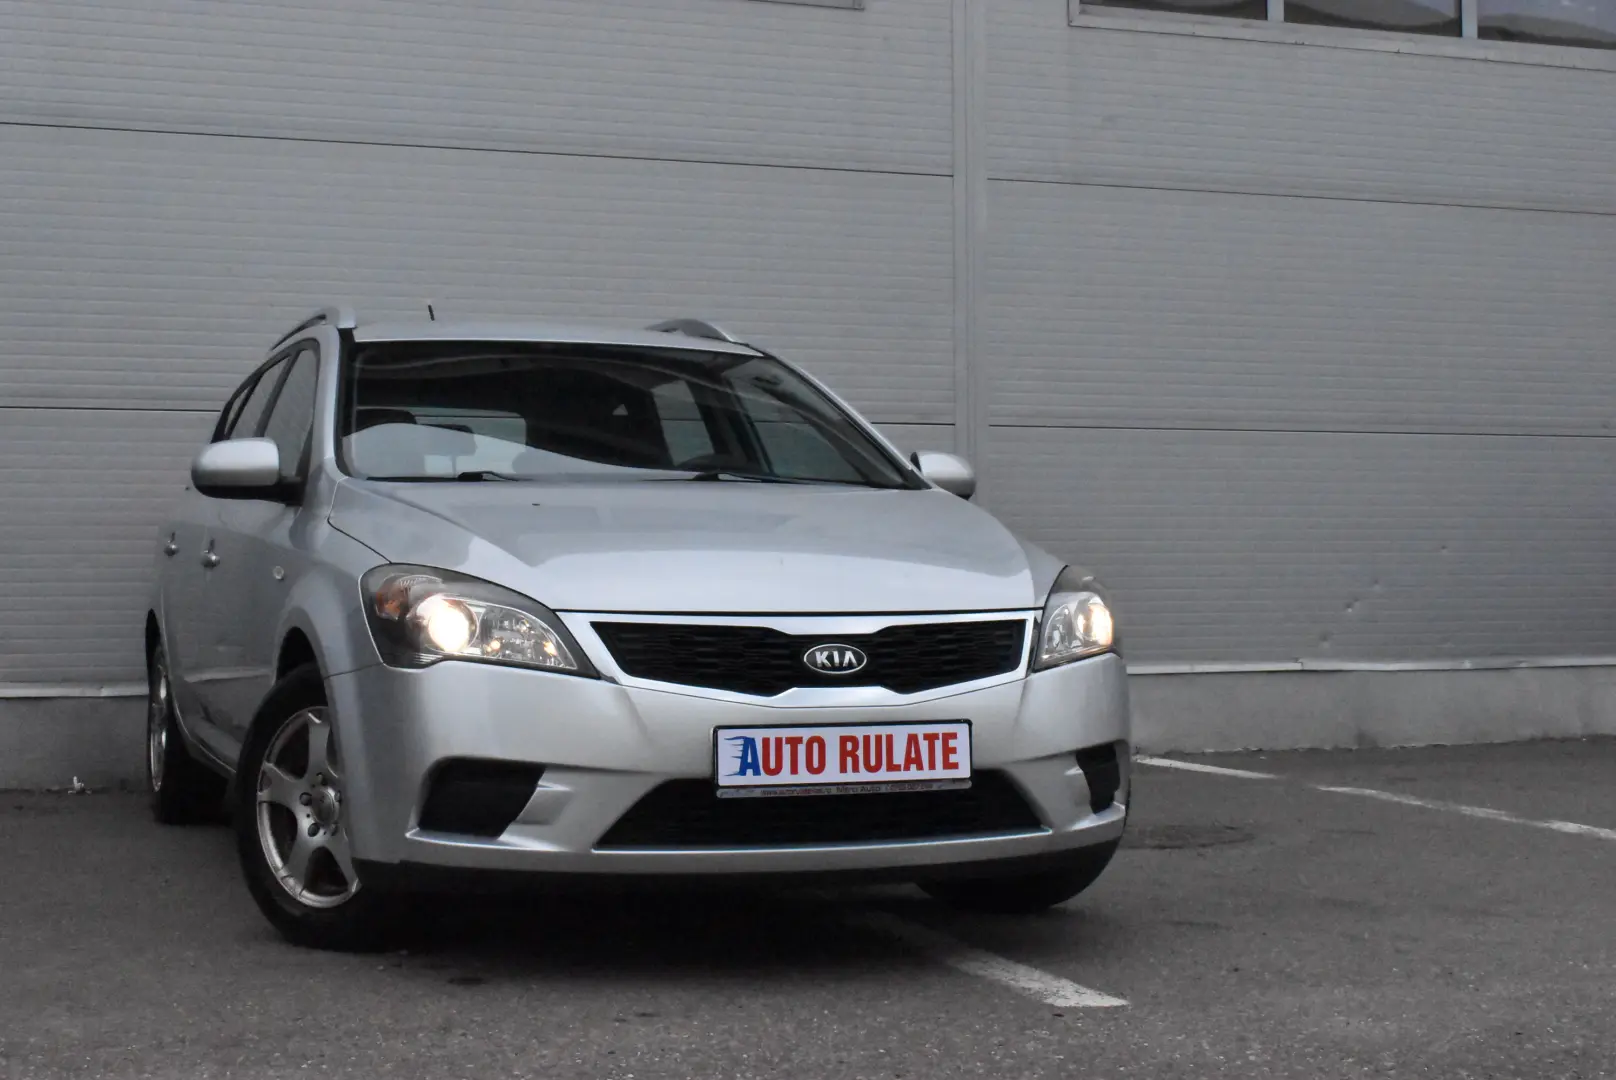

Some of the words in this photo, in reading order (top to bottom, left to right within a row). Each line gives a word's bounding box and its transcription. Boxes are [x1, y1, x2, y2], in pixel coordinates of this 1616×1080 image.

[815, 650, 858, 667] KIA
[724, 735, 827, 776] AUTO
[839, 732, 959, 774] RULATE
